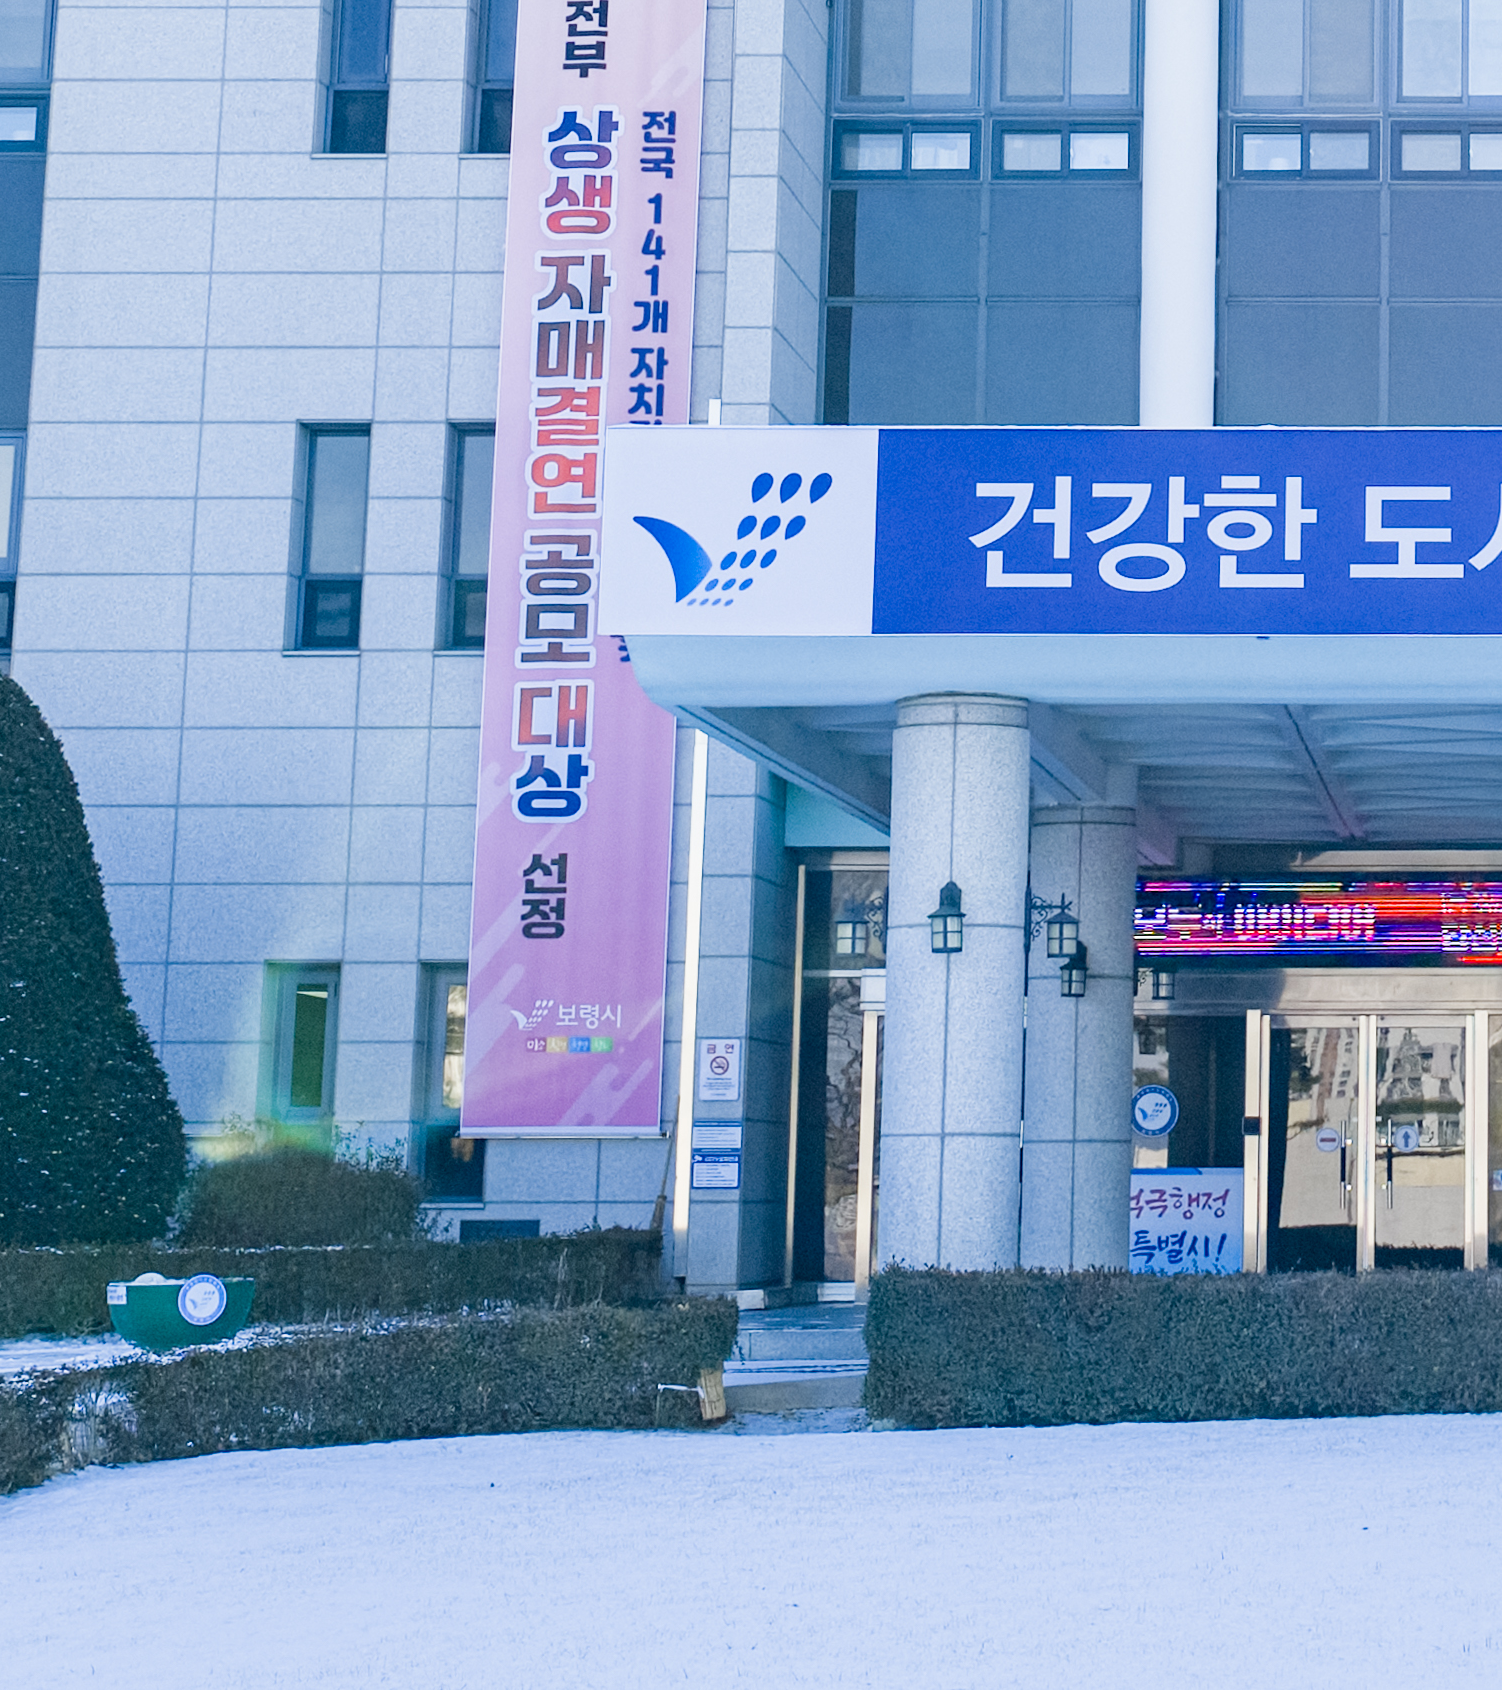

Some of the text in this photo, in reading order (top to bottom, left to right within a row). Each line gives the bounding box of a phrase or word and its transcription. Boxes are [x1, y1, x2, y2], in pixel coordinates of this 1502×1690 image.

[626, 110, 677, 426] 전국 141개 자치
[513, 107, 620, 940] 상생 자매결연 공모 대상 선정
[970, 475, 1319, 593] 건강한
[555, 1004, 622, 1030] 보령시
[1130, 1230, 1227, 1264] 특별시!
